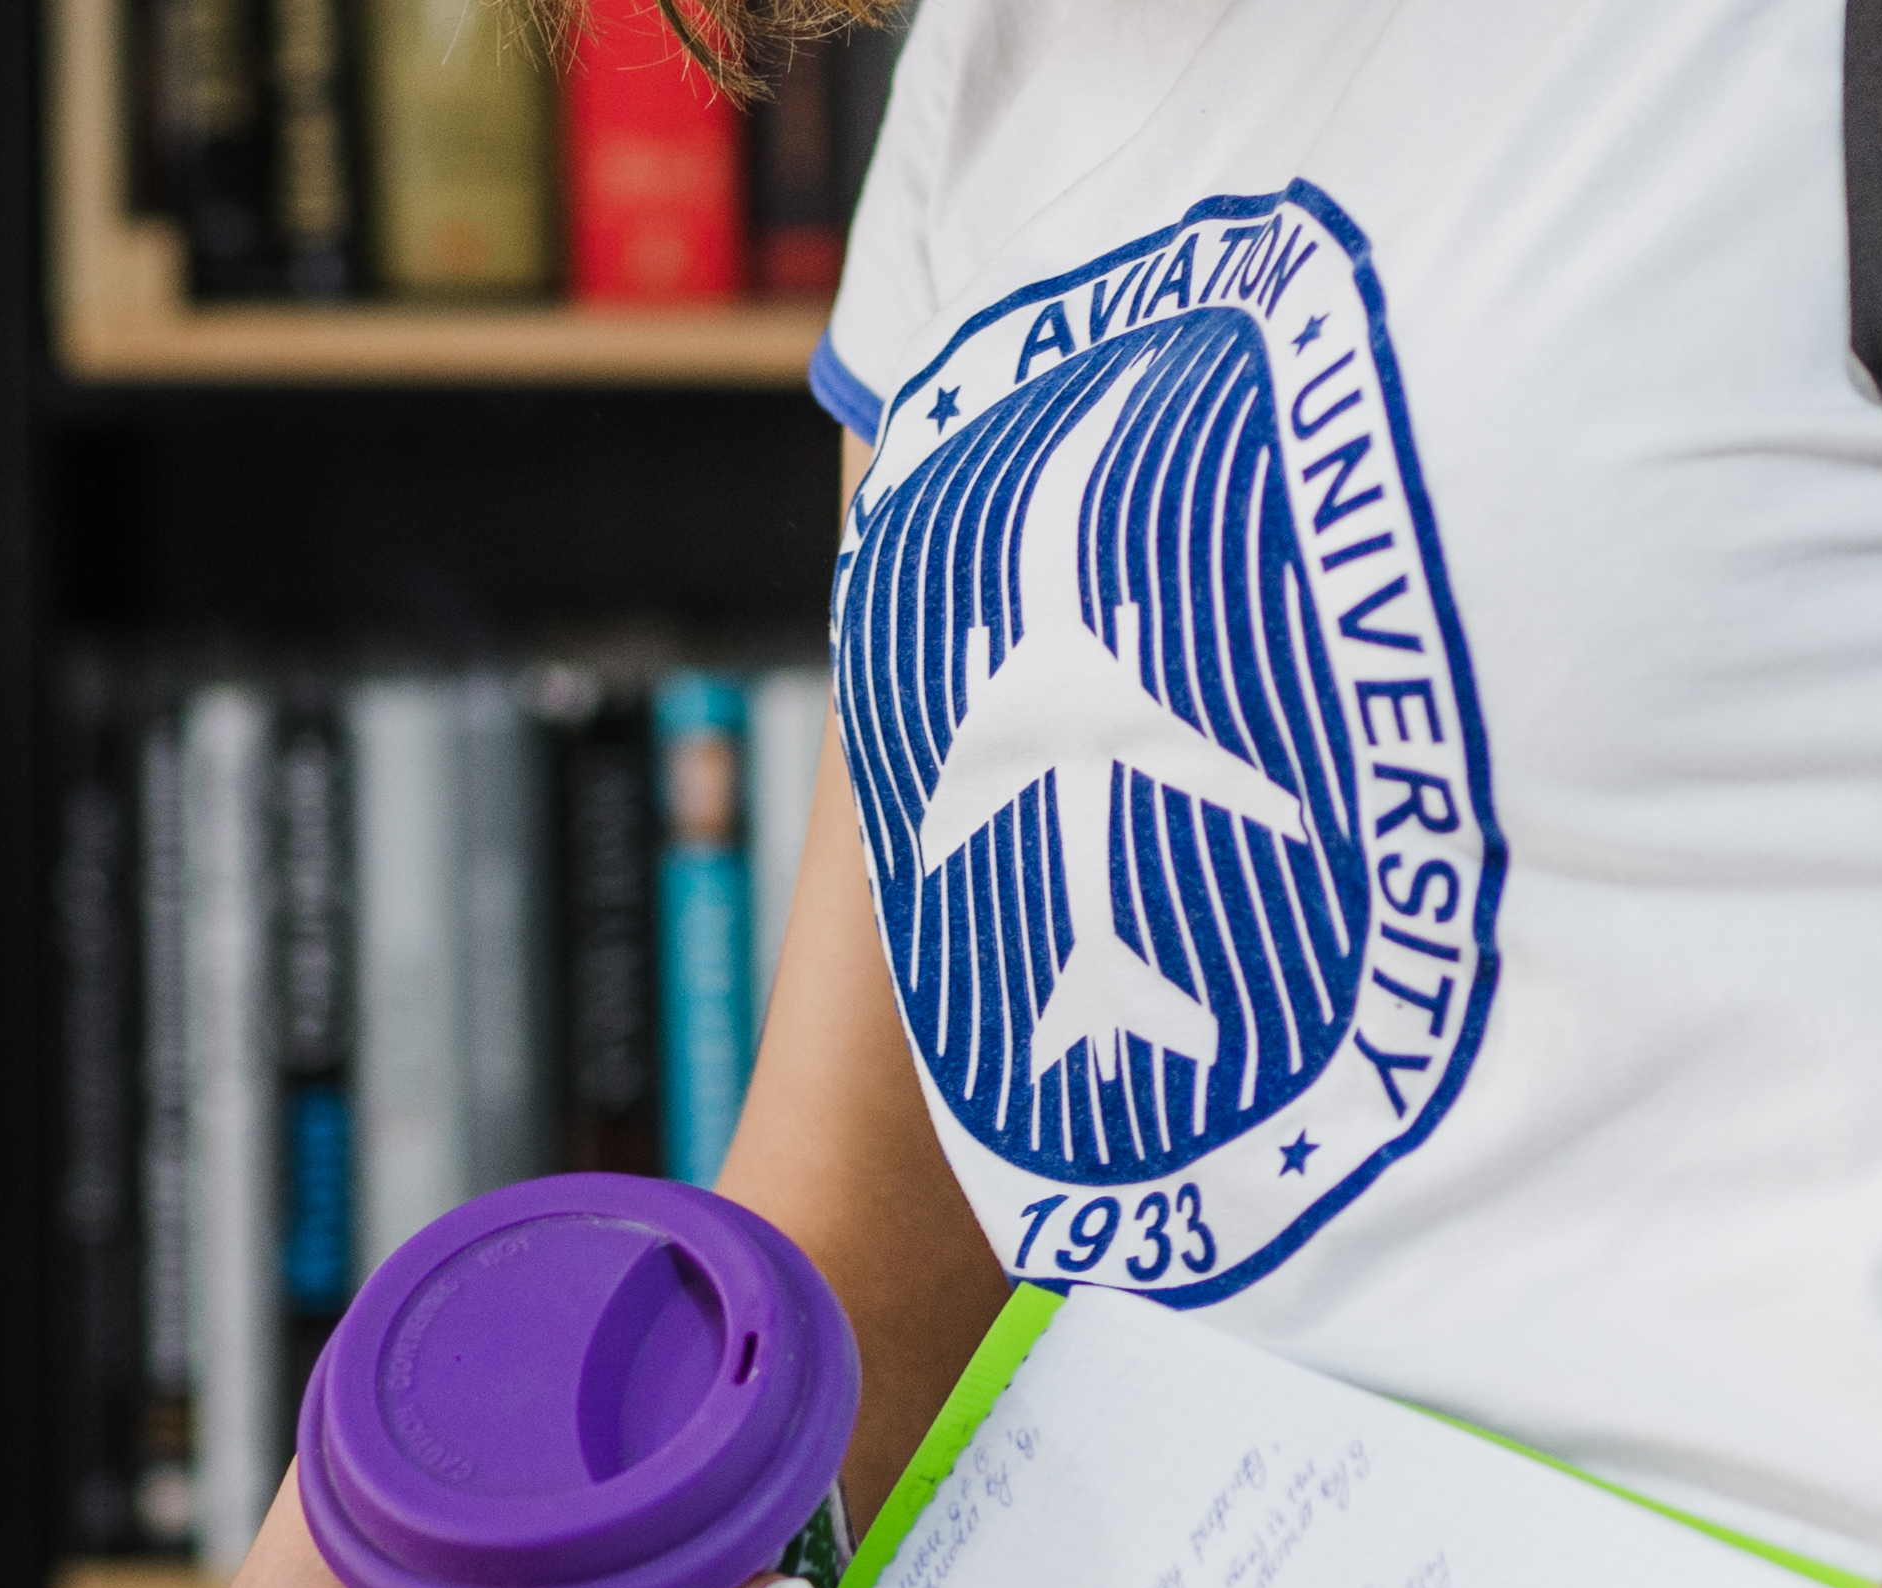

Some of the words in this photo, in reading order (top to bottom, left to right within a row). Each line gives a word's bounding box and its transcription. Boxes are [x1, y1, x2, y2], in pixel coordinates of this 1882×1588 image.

[1015, 212, 1318, 383] AVIATION
[1293, 352, 1460, 1118] UNIVERSITY
[1016, 1179, 1216, 1282] 1933
